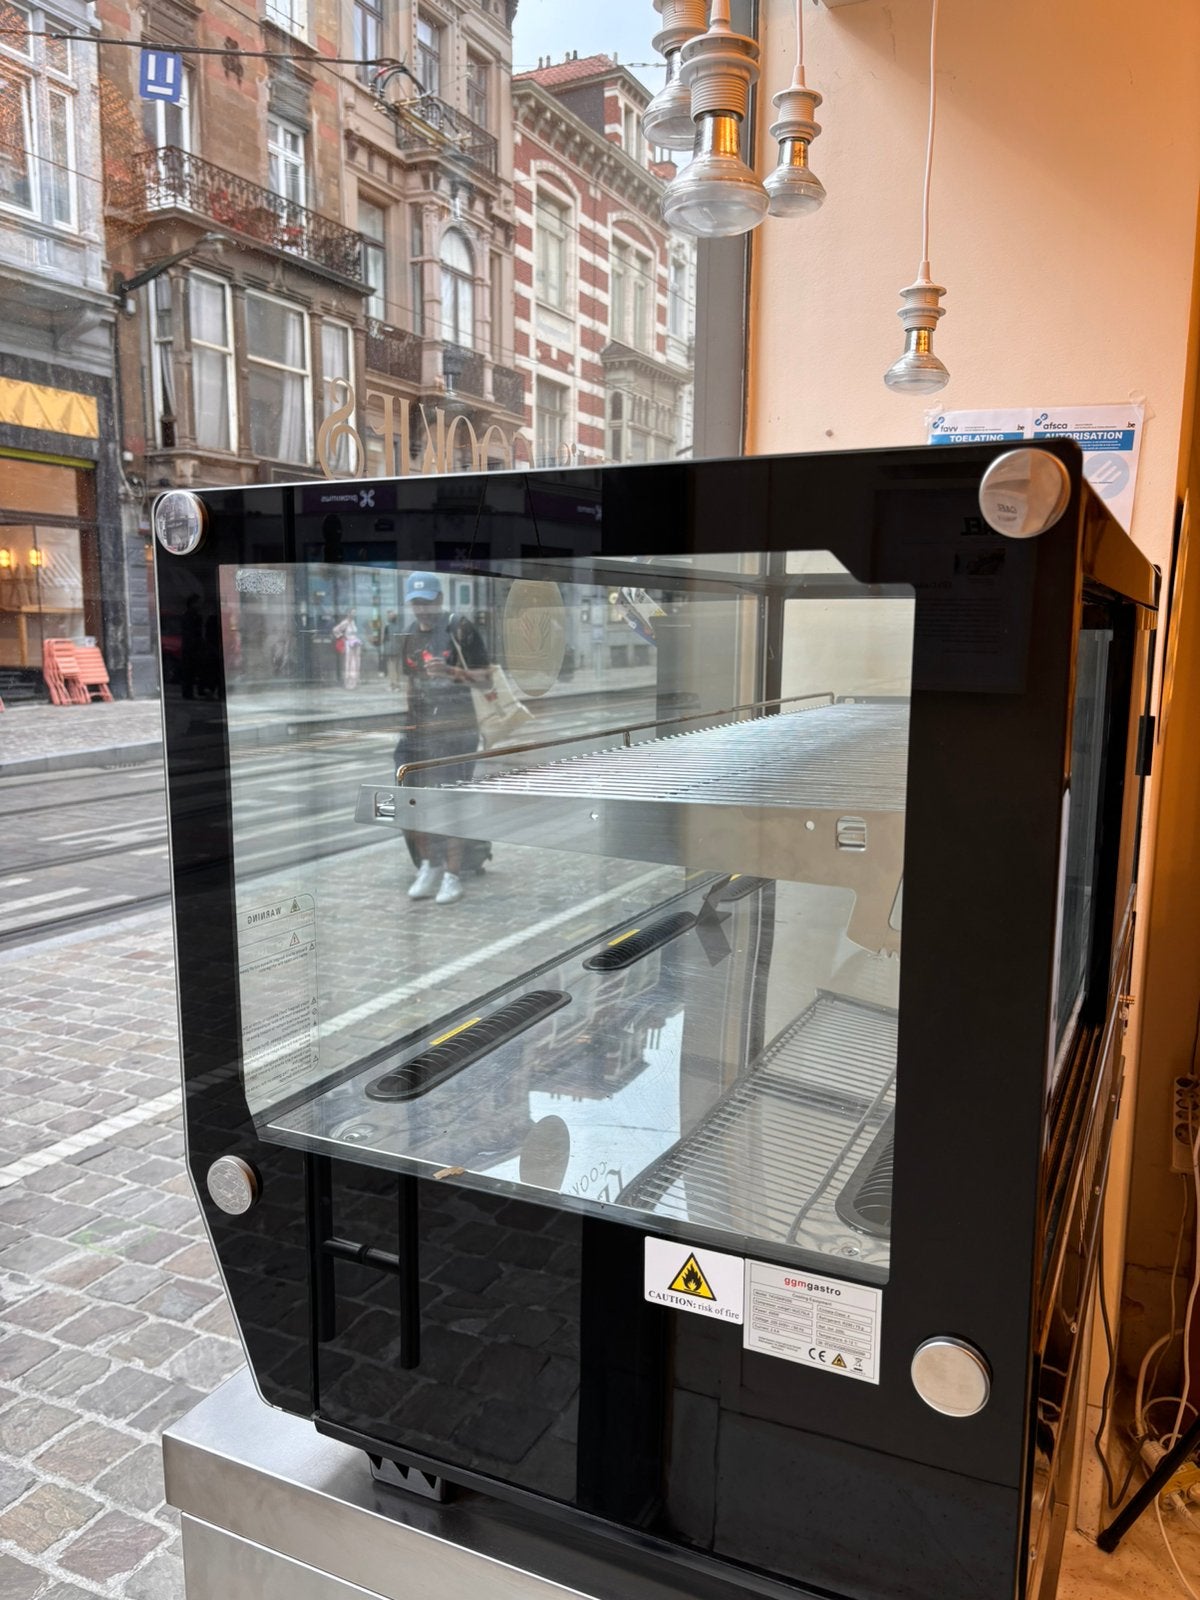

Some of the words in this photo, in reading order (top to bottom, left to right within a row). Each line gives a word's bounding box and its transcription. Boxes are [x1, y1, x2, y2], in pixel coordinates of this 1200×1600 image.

[940, 424, 958, 432] favv
[1042, 421, 1067, 430] afsca
[1126, 420, 1136, 428] .be
[949, 433, 1004, 442] TOELATING
[784, 1277, 841, 1296] ggmgastro
[648, 1290, 697, 1309] CAUTION:
[698, 1303, 713, 1314] risk
[714, 1306, 725, 1316] of
[725, 1308, 740, 1320] fire
